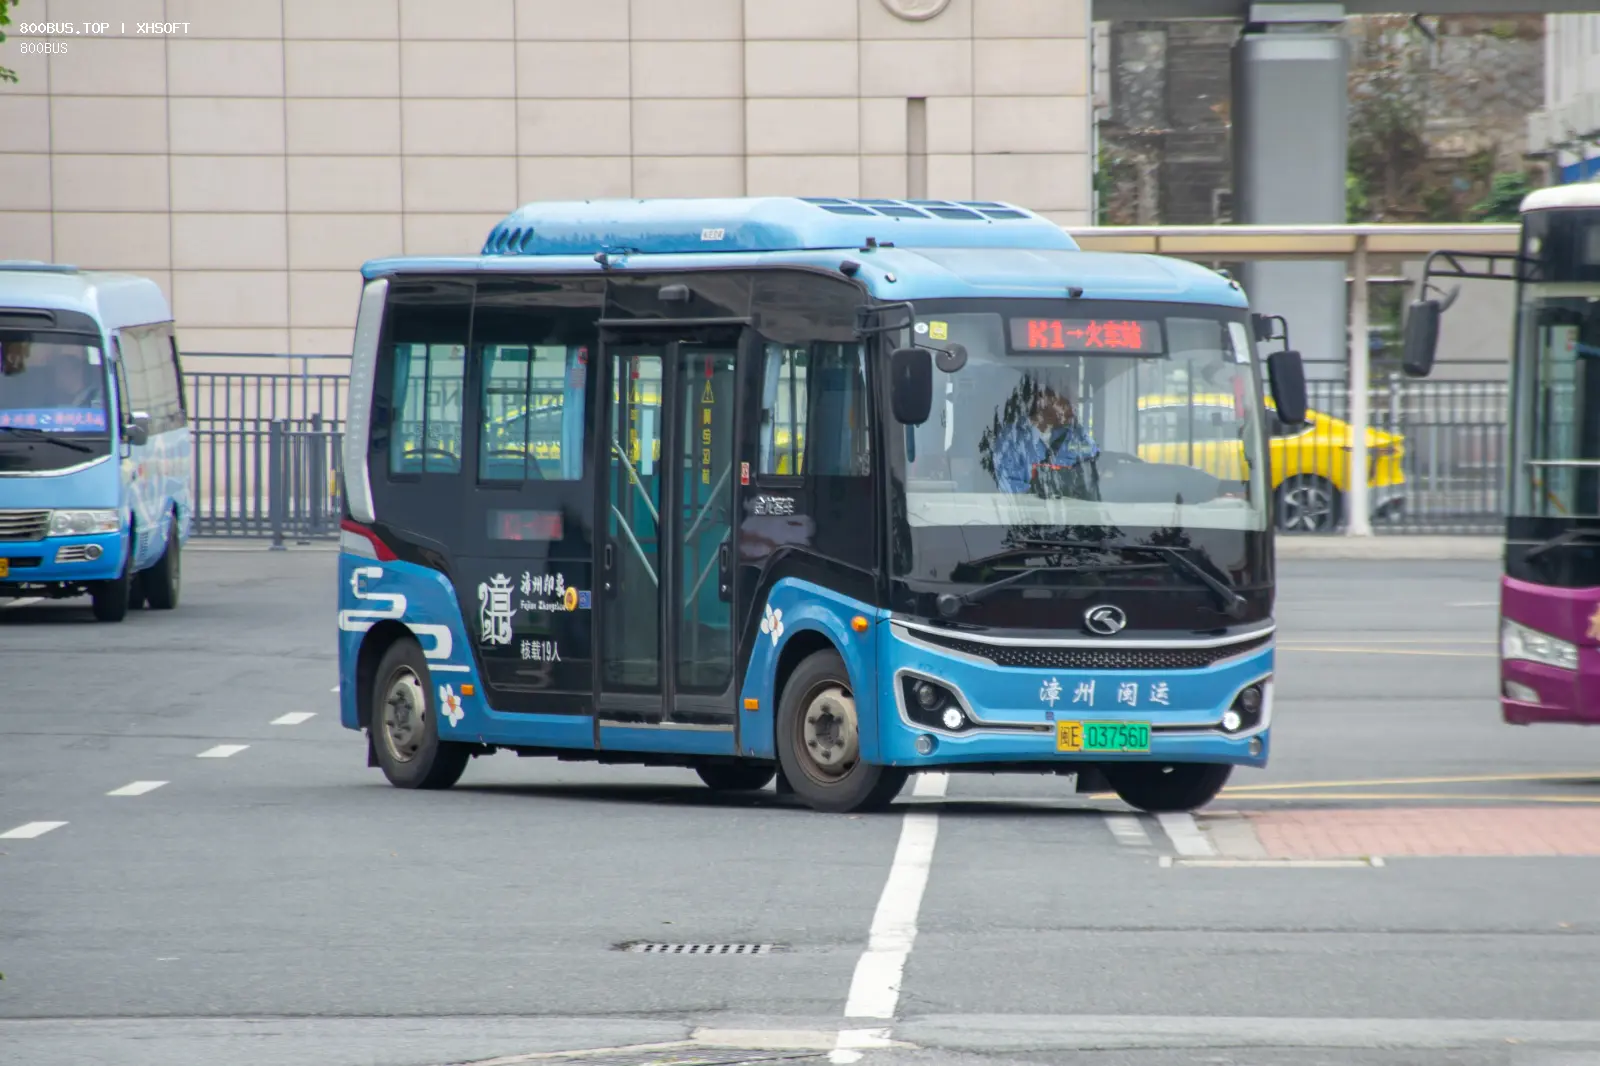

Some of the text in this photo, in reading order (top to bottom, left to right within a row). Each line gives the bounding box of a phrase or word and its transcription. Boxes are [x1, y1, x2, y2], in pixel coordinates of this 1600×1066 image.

[1028, 320, 1065, 348] K1
[520, 571, 566, 597] 漳州印象
[520, 640, 562, 662] 核载19人
[1039, 677, 1171, 707] 漳州闽运
